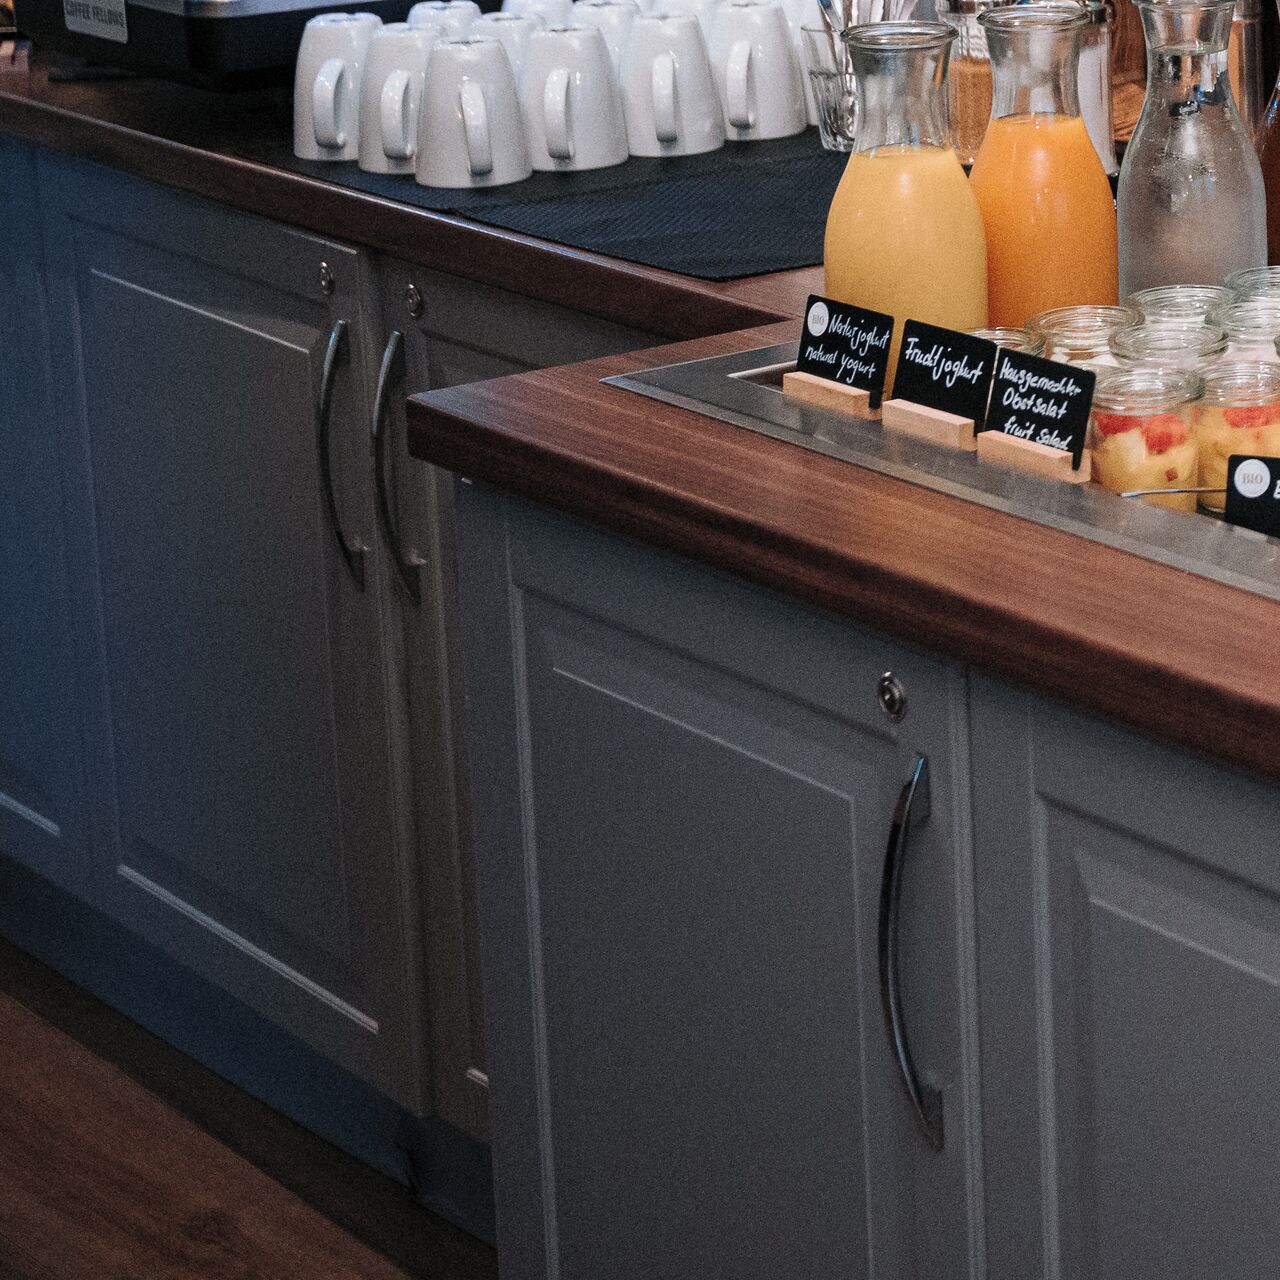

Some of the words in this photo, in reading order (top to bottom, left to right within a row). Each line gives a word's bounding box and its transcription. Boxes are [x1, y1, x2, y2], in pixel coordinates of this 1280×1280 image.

[805, 343, 838, 364] natural
[836, 354, 877, 384] yogurt
[1004, 416, 1036, 440] fruit
[1242, 473, 1263, 485] BIO
